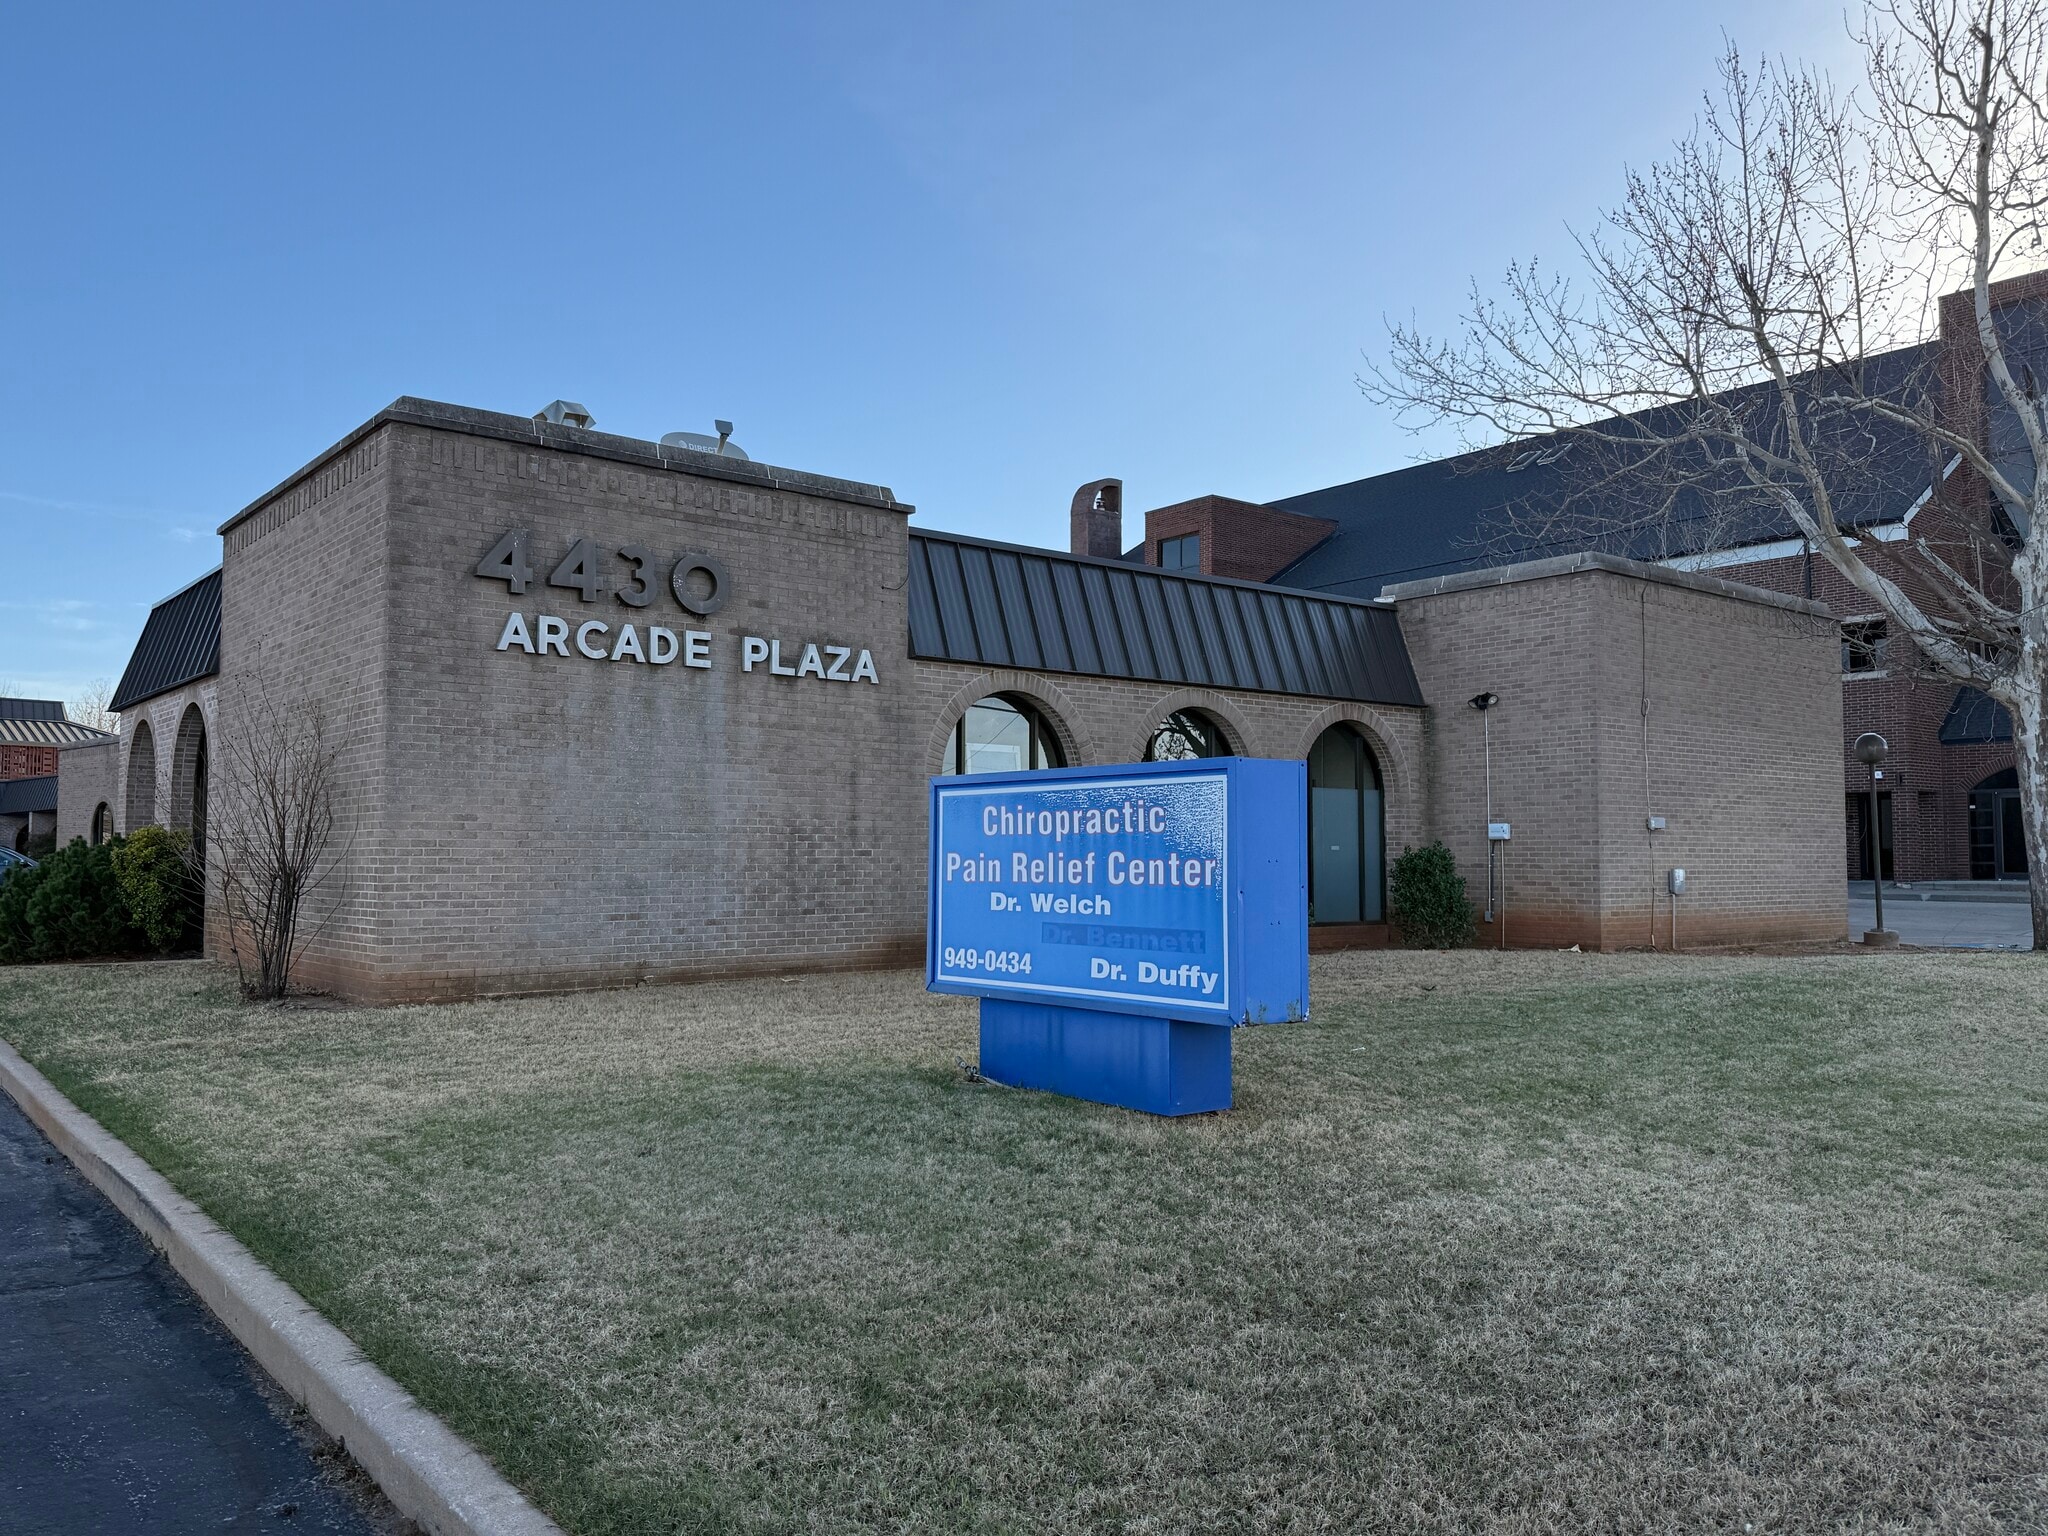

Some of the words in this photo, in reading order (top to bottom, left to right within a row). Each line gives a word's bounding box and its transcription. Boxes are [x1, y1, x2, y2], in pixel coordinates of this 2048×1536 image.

[475, 528, 730, 616] 4430
[497, 612, 712, 669] ARCADE
[742, 636, 879, 684] PLAZA
[983, 800, 1166, 842] Chiropractic
[946, 852, 1001, 882] Pain
[1012, 852, 1096, 884] Relief
[1107, 851, 1216, 886] Center
[990, 892, 1022, 911] Dr.
[1030, 893, 1111, 915] Welch
[1043, 922, 1075, 944] Dr.
[1087, 926, 1206, 952] Bennett
[944, 947, 1032, 974] 949-0434
[1090, 957, 1127, 981] Dr.
[1138, 962, 1219, 994] Duffy
